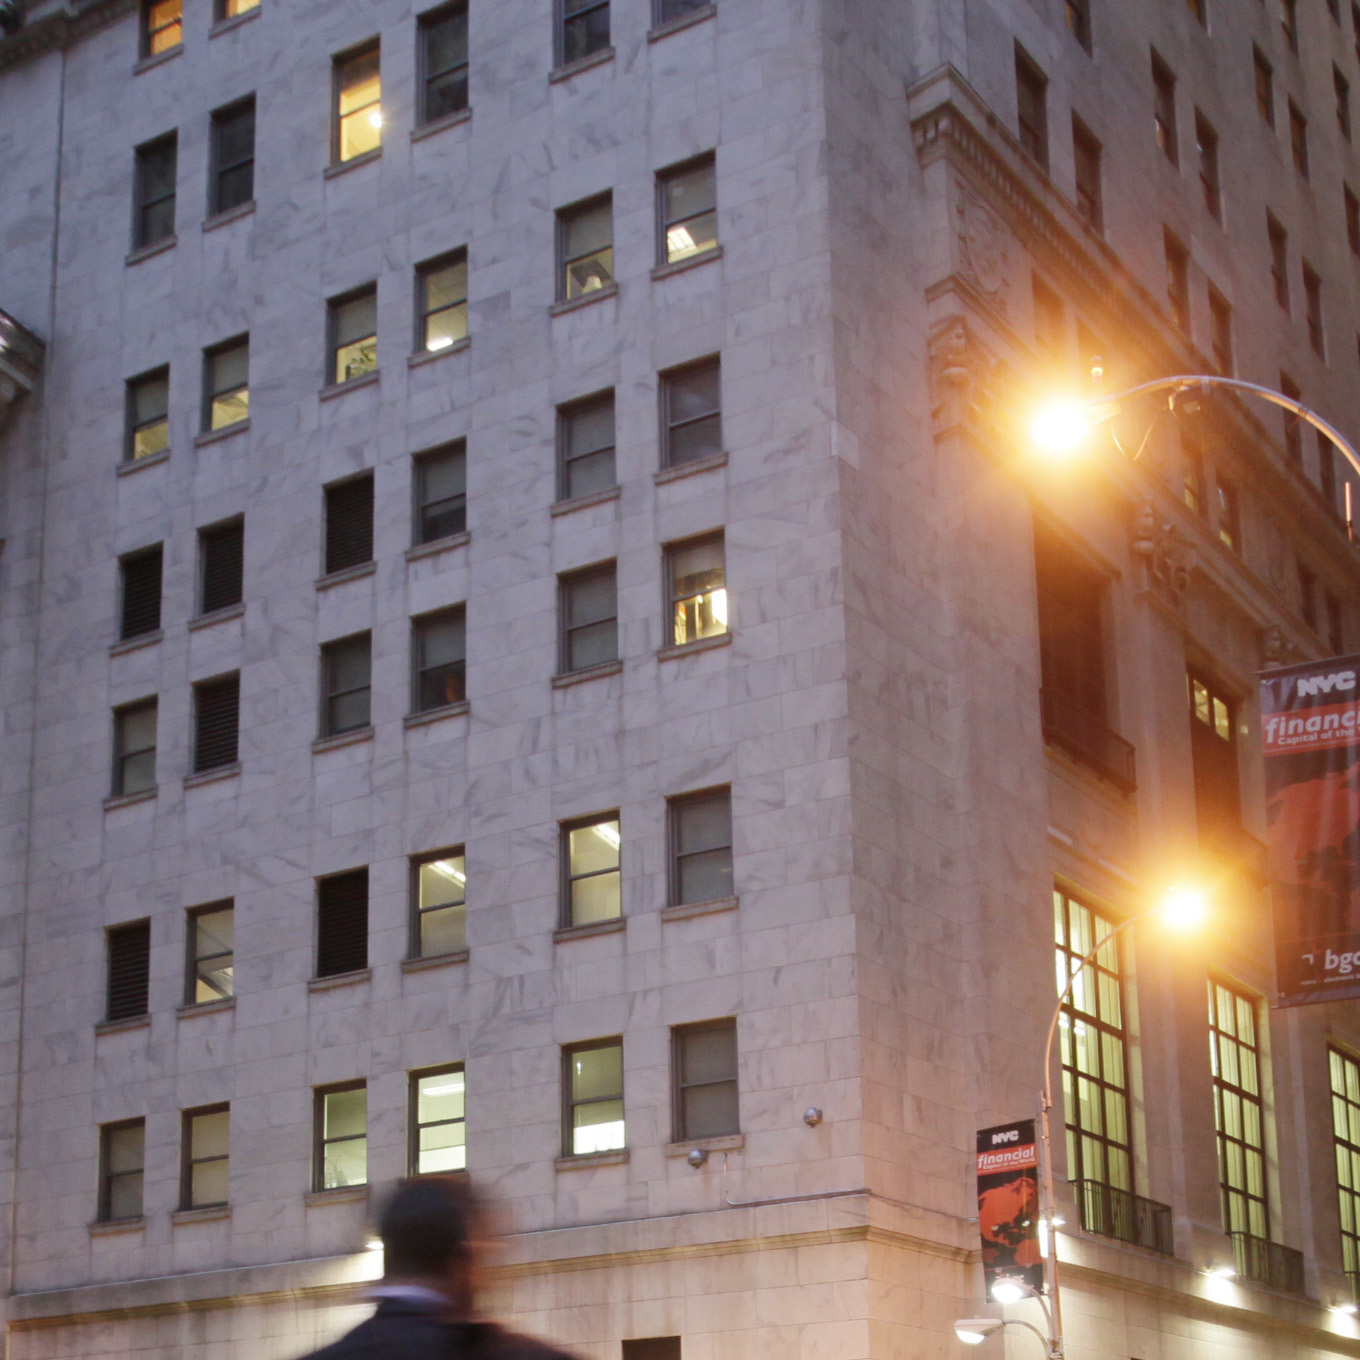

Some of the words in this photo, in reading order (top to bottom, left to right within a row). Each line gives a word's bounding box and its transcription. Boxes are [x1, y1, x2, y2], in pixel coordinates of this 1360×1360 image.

[1297, 670, 1357, 697] NYC
[1277, 732, 1318, 746] Capital
[1321, 730, 1333, 740] of
[1336, 727, 1354, 738] the
[992, 1130, 1019, 1144] NYC
[978, 1146, 1034, 1168] financial
